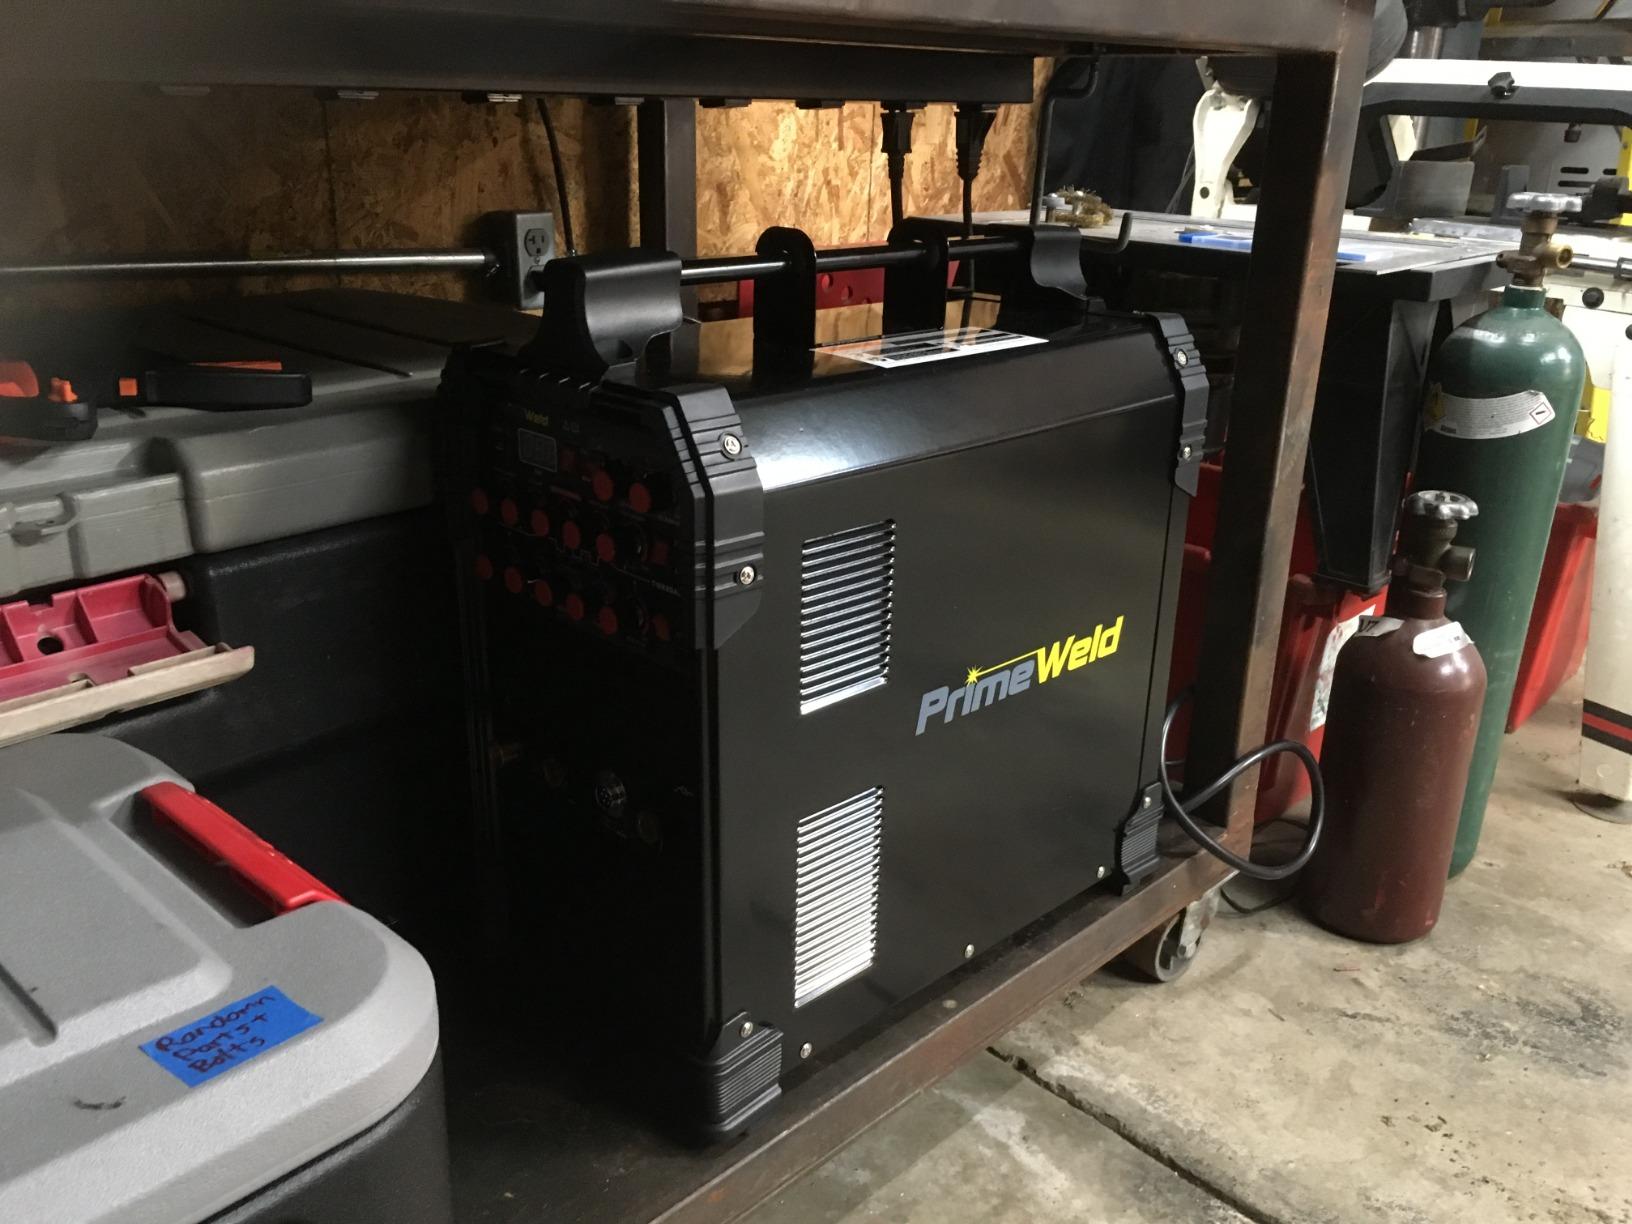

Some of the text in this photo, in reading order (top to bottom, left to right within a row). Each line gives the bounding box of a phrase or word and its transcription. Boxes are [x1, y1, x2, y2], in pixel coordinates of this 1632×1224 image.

[915, 615, 1124, 736] PrimeWeld
[156, 996, 275, 1052] Random
[187, 1035, 266, 1073] Bolts
